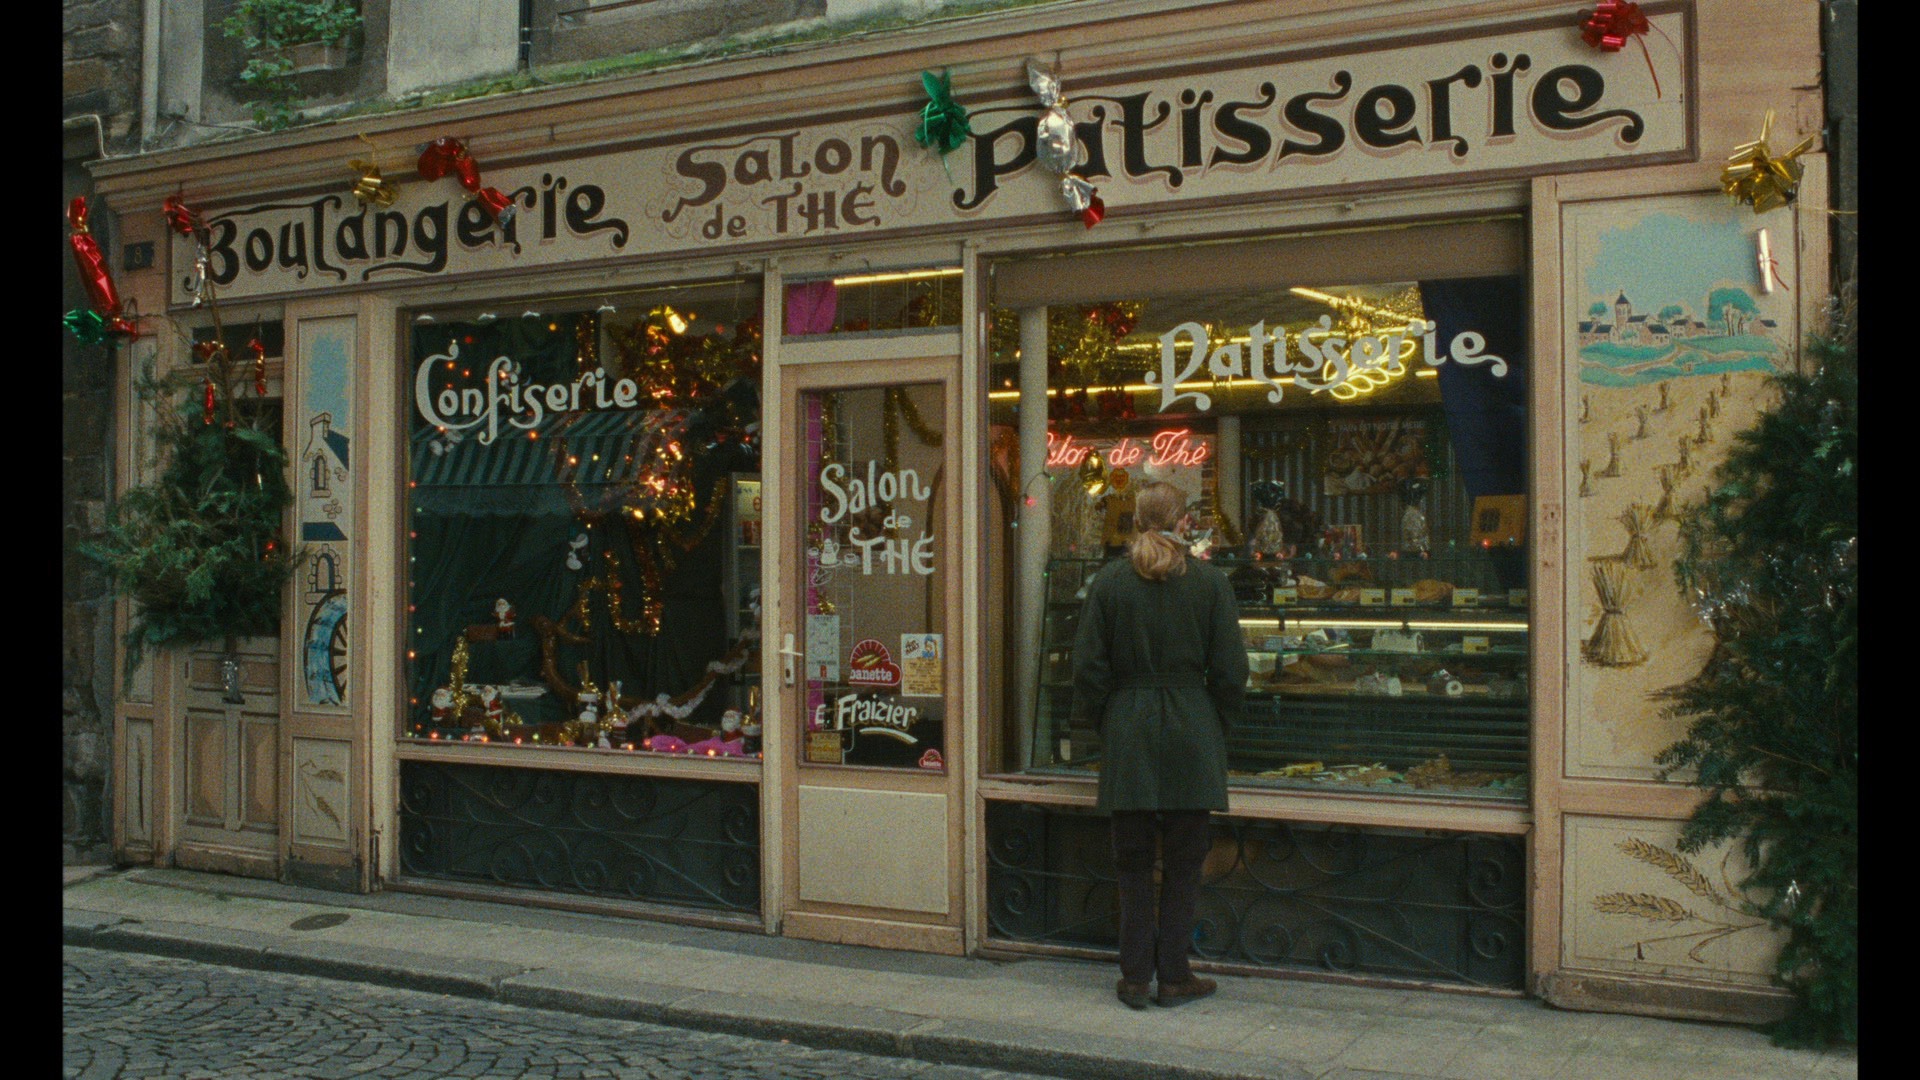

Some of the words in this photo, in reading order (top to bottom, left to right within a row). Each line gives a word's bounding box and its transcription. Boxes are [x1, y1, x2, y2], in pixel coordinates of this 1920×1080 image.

[953, 52, 1644, 211] Patisserie
[662, 131, 906, 223] Salon
[184, 172, 629, 292] Boulangerie
[702, 202, 747, 240] de
[415, 343, 639, 446] Confiserie
[1145, 314, 1508, 413] Patisserie
[1047, 432, 1094, 465] alo
[1109, 438, 1140, 466] de
[820, 459, 931, 524] Salon
[883, 509, 912, 529] de
[814, 703, 831, 726] E.
[837, 693, 918, 731] Fraizier
